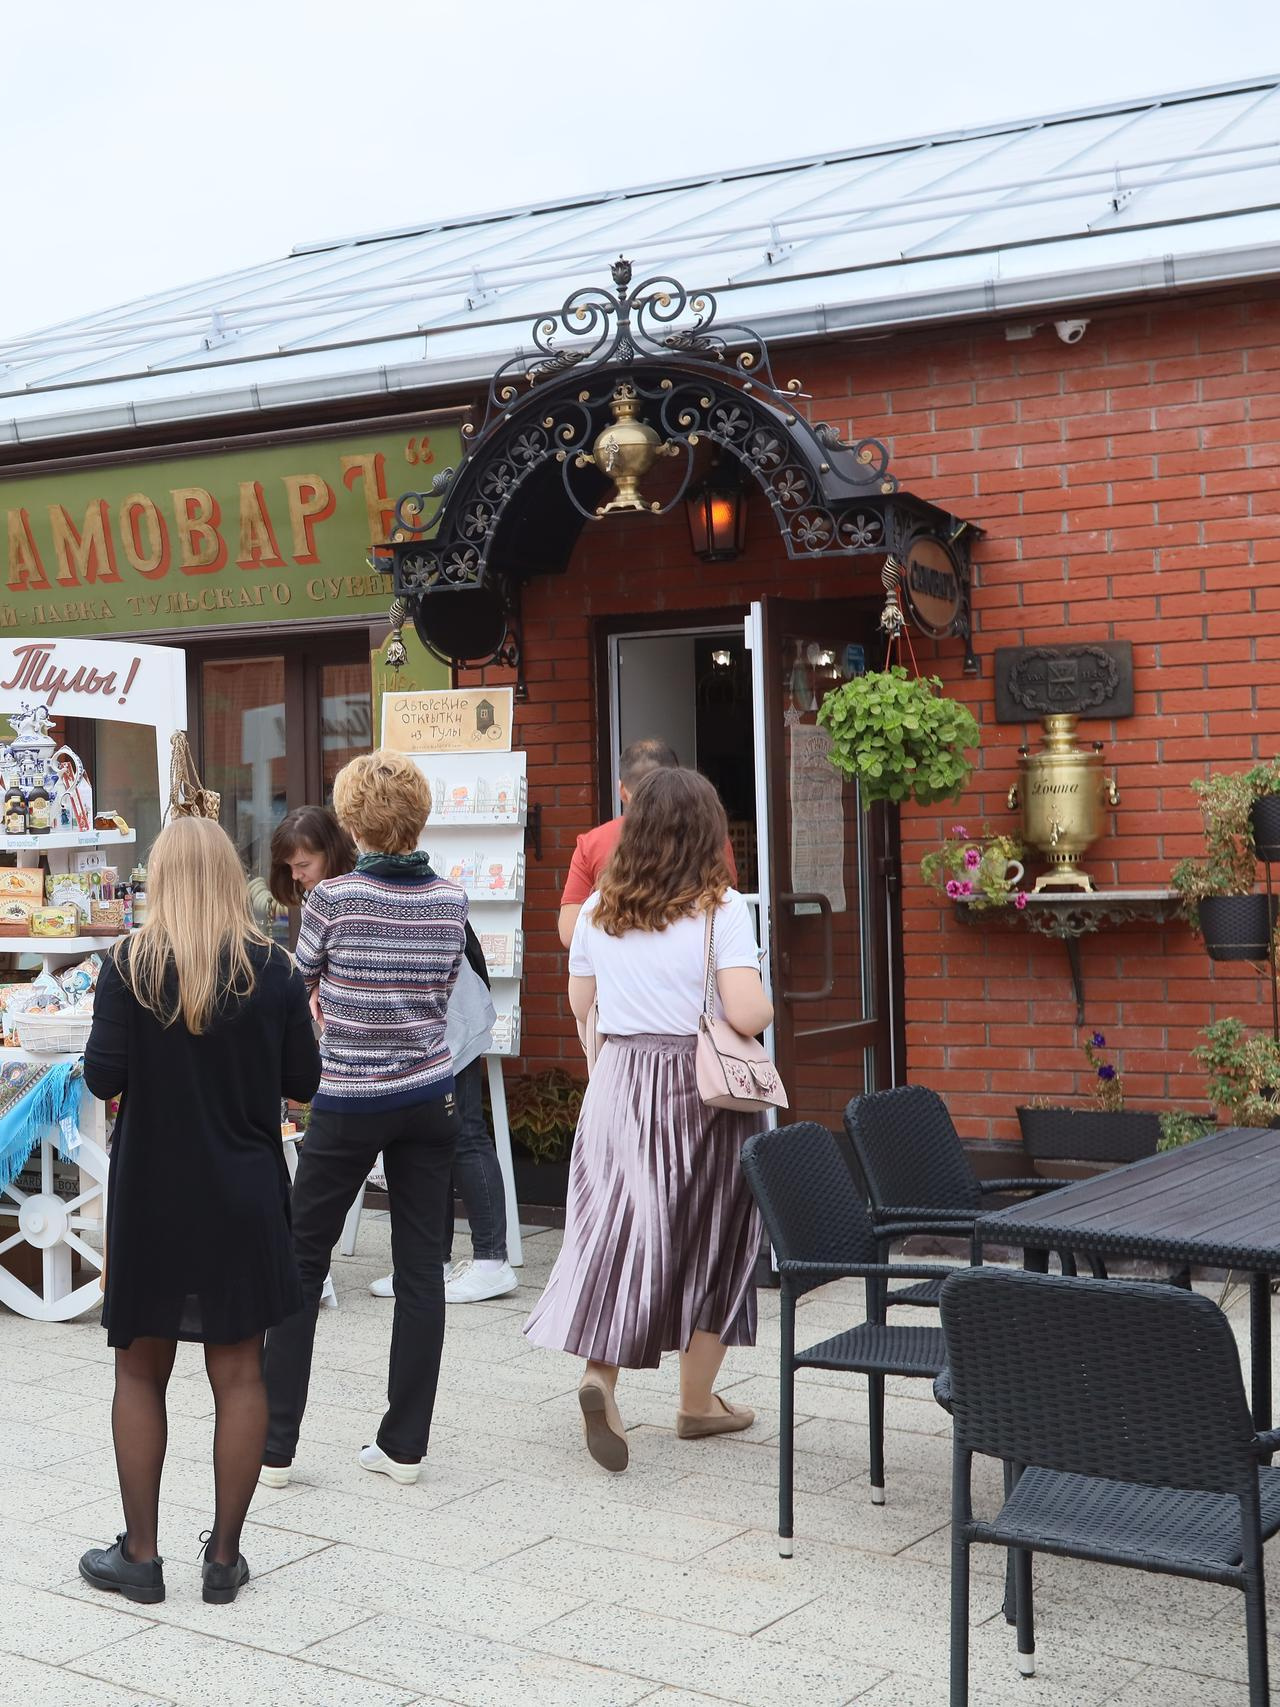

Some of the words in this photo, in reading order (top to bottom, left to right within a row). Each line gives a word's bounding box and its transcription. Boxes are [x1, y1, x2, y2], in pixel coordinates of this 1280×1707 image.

[128, 583, 292, 616] ТУЛЬСКАГО
[1, 643, 141, 706] Тулы!
[58, 1181, 78, 1190] BOX
